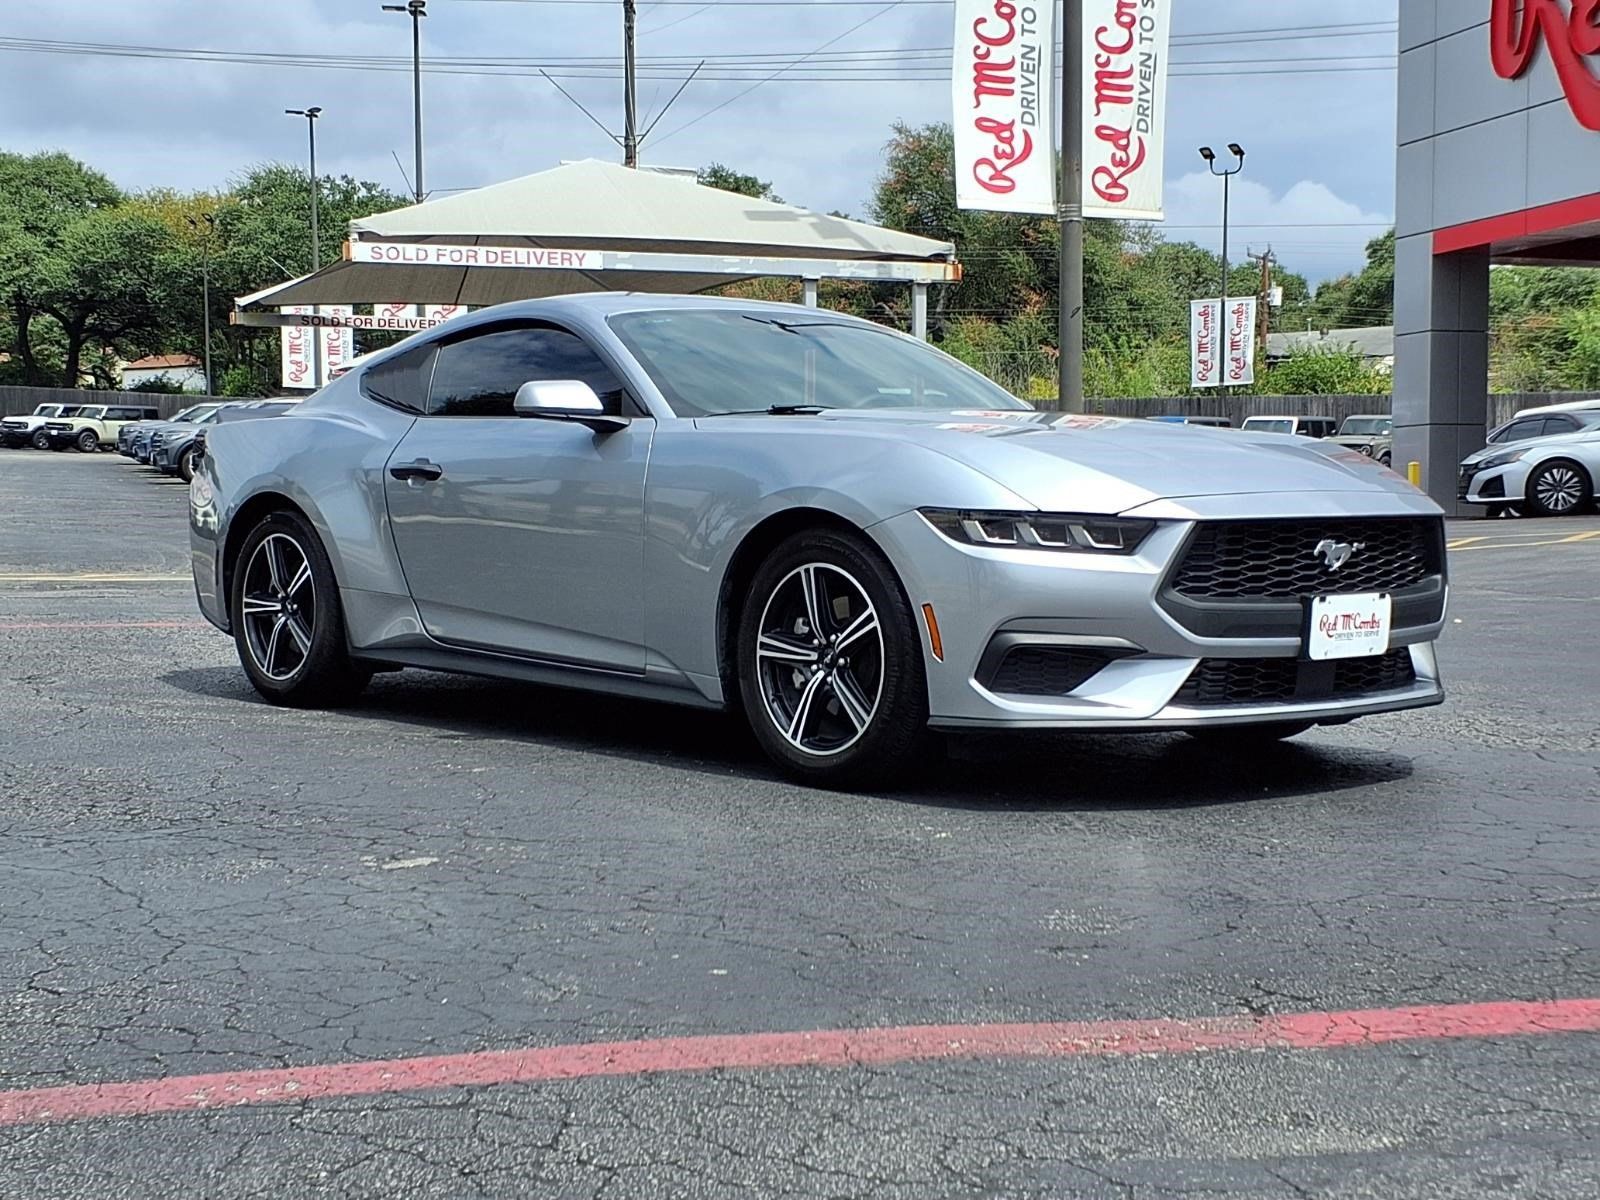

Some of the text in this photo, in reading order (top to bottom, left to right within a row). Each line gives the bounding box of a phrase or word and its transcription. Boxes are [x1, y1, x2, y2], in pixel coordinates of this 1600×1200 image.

[1020, 7, 1037, 127] DRIVEN TO
[1139, 15, 1155, 45] TO
[973, 0, 1033, 194] Red McCo
[1136, 52, 1153, 134] DRIVEN
[1091, 125, 1146, 203] Red
[370, 245, 587, 267] SOLD FOR DELIVERY
[301, 315, 446, 330] SOLD FOR DELIVER
[1197, 305, 1214, 382] Red McCombs
[1229, 303, 1246, 380] Red McCombs
[288, 359, 309, 383] Red
[1319, 612, 1381, 638] Red McCombs
